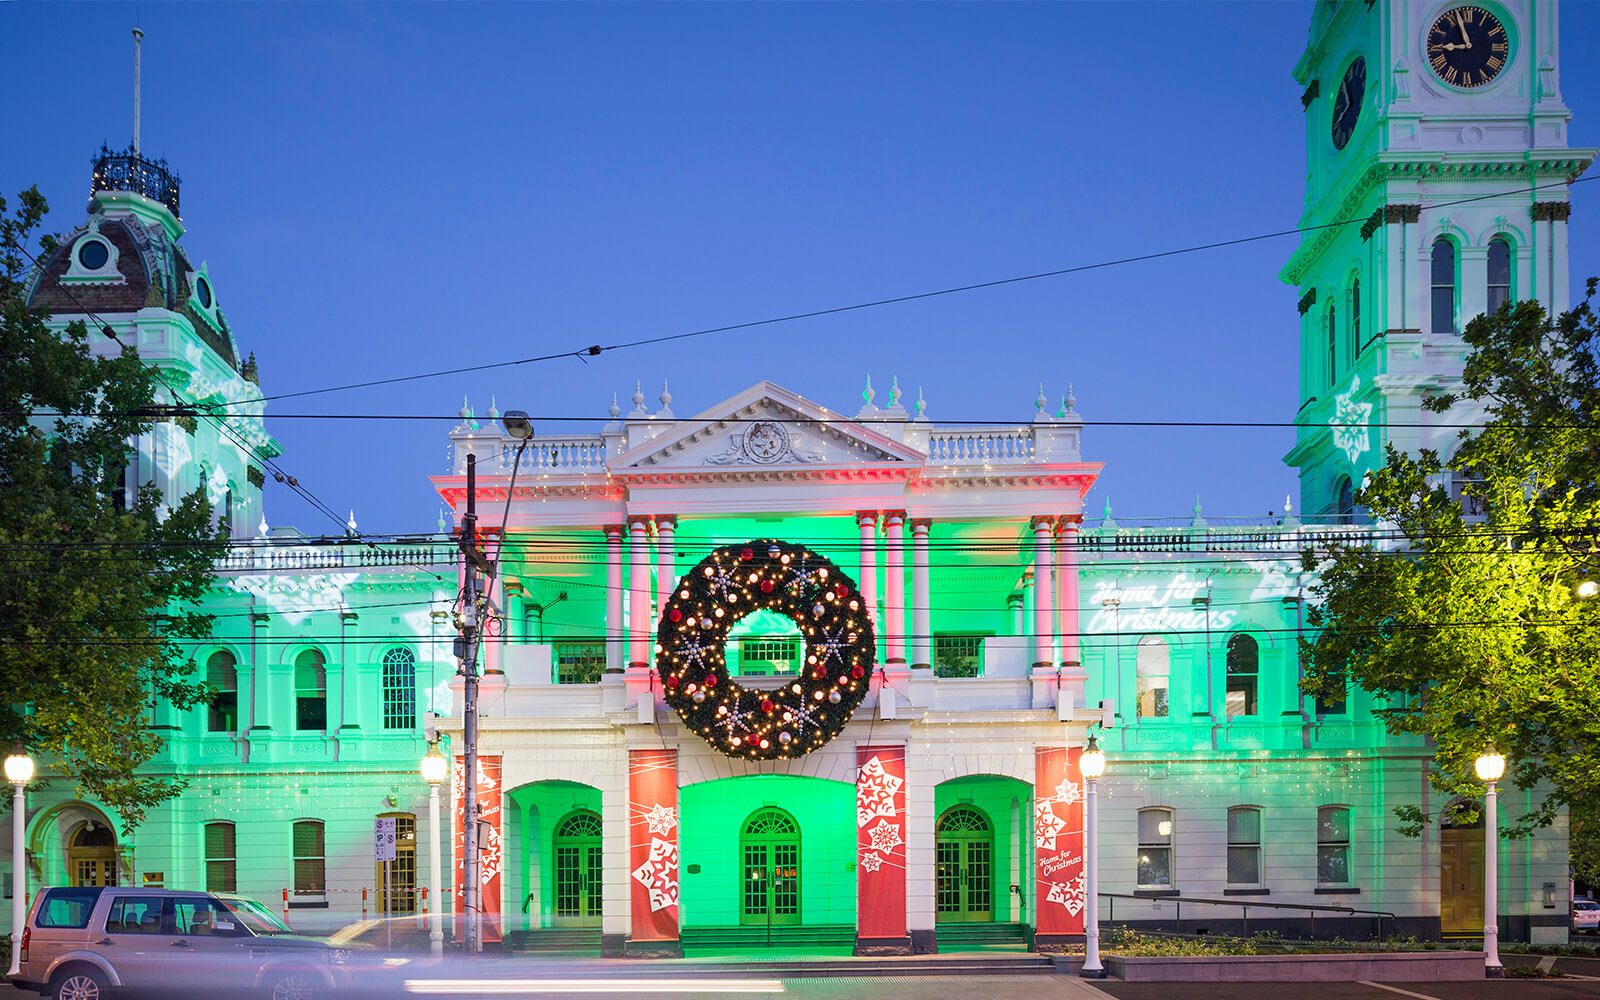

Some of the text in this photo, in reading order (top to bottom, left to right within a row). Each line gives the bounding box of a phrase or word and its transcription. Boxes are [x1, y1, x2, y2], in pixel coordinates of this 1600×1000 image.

[1089, 573, 1213, 606] Home for
[1086, 606, 1238, 633] Christmas
[1039, 850, 1071, 866] Home for
[1043, 856, 1081, 876] Christmas
